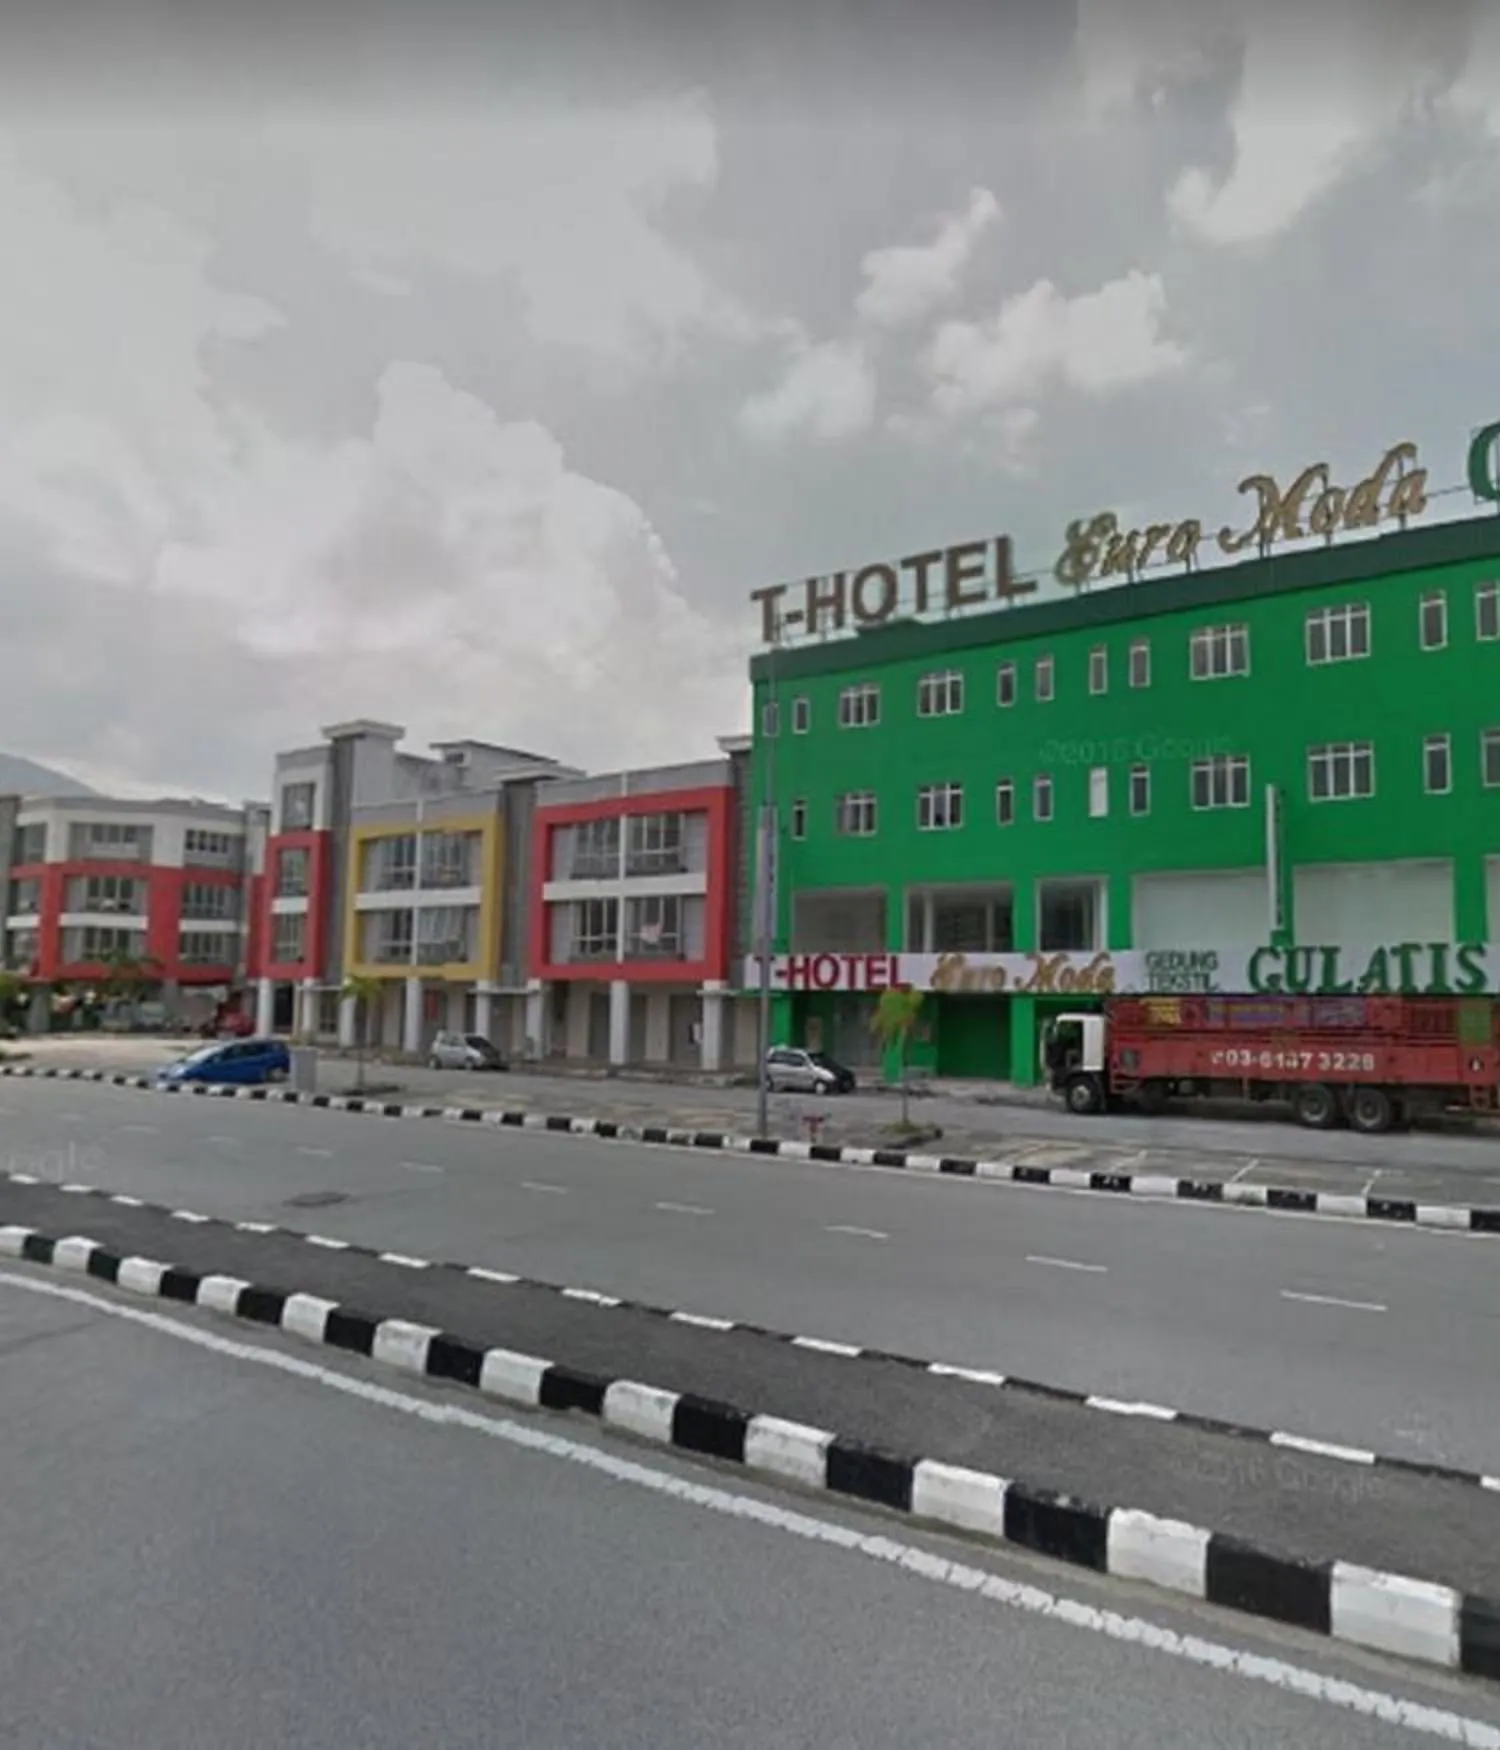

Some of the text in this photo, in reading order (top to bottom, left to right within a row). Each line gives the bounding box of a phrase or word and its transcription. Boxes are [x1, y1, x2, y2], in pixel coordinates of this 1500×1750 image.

[1053, 442, 1429, 588] Euro Moda
[750, 535, 1038, 643] T-HOTEL
[754, 953, 914, 992] T-HOTEL
[930, 951, 1115, 994] Euro Moda
[1145, 949, 1219, 972] GEDUNG
[1248, 943, 1489, 995] GULATIS
